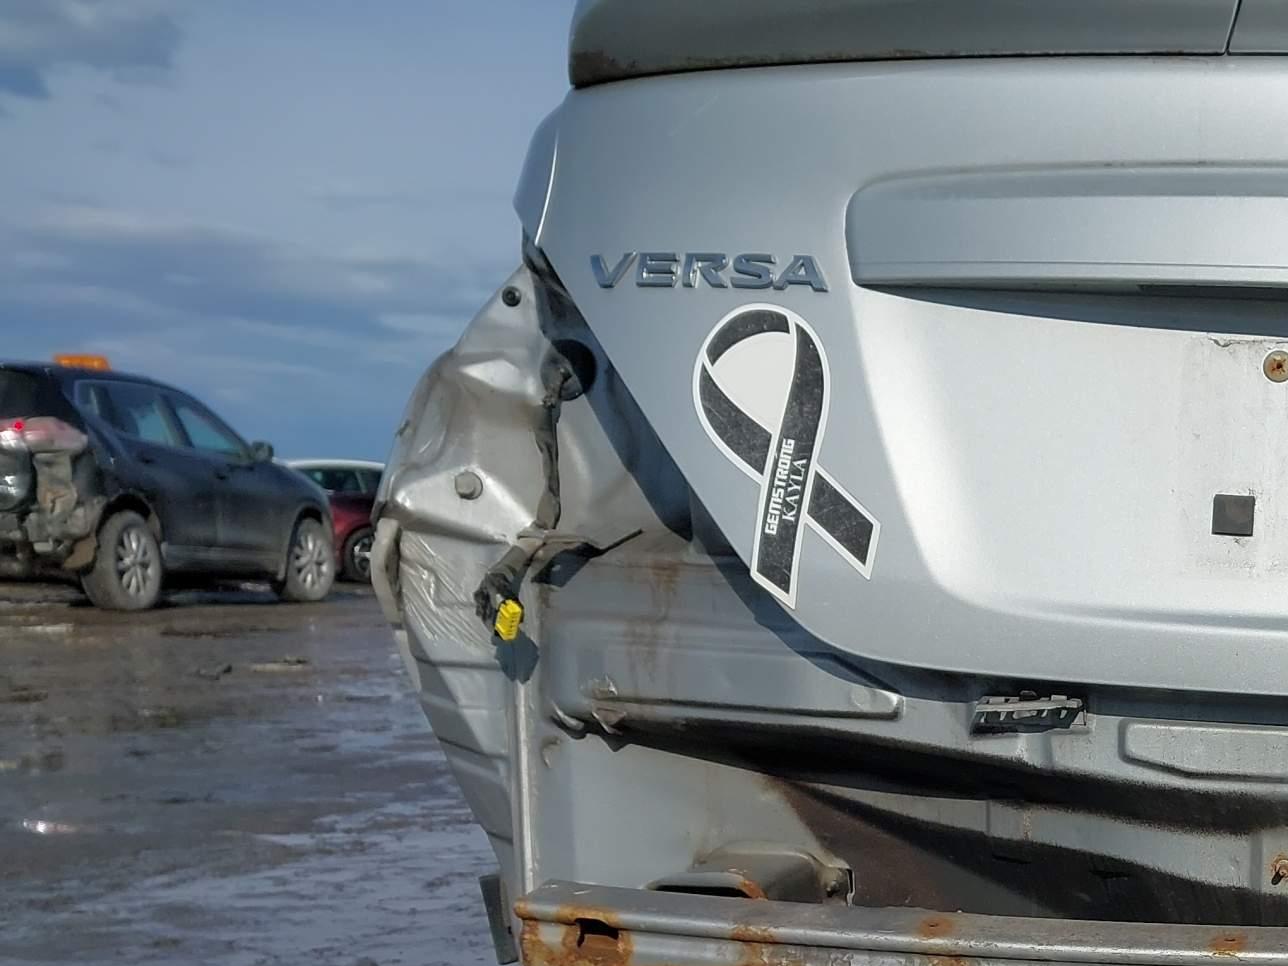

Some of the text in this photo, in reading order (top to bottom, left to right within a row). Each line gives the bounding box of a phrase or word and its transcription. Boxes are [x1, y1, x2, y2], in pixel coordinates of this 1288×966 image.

[590, 250, 829, 292] VERSA
[764, 438, 795, 536] GEMSTRONG
[782, 459, 807, 522] KAYLA
